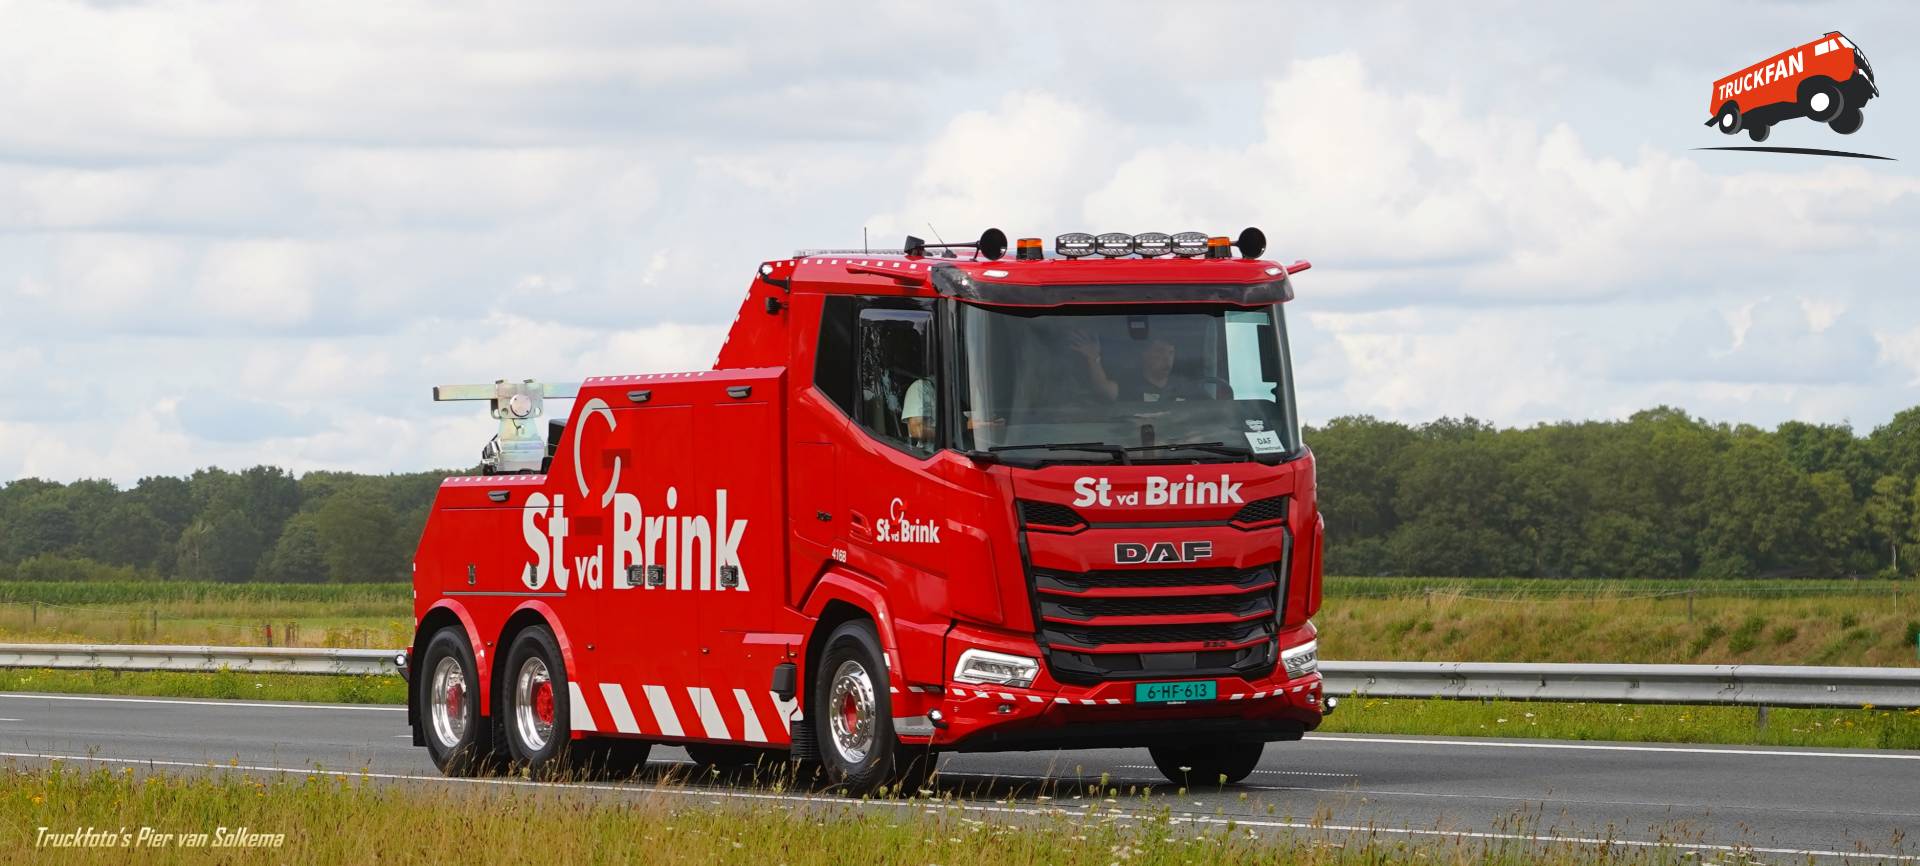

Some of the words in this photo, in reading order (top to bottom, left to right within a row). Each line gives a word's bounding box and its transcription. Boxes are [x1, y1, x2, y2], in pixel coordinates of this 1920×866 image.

[1257, 437, 1272, 445] DAF
[1073, 477, 1113, 508] St
[1116, 491, 1139, 506] vd
[1145, 474, 1245, 506] Brink
[522, 492, 570, 592] St
[575, 545, 603, 590] vd
[613, 486, 750, 592] Brink
[876, 518, 891, 542] St
[891, 531, 900, 543] vd
[901, 518, 941, 544] Brink
[831, 547, 848, 563] 4168
[1114, 541, 1213, 564] DAF
[1147, 683, 1208, 700] 6-HF-613
